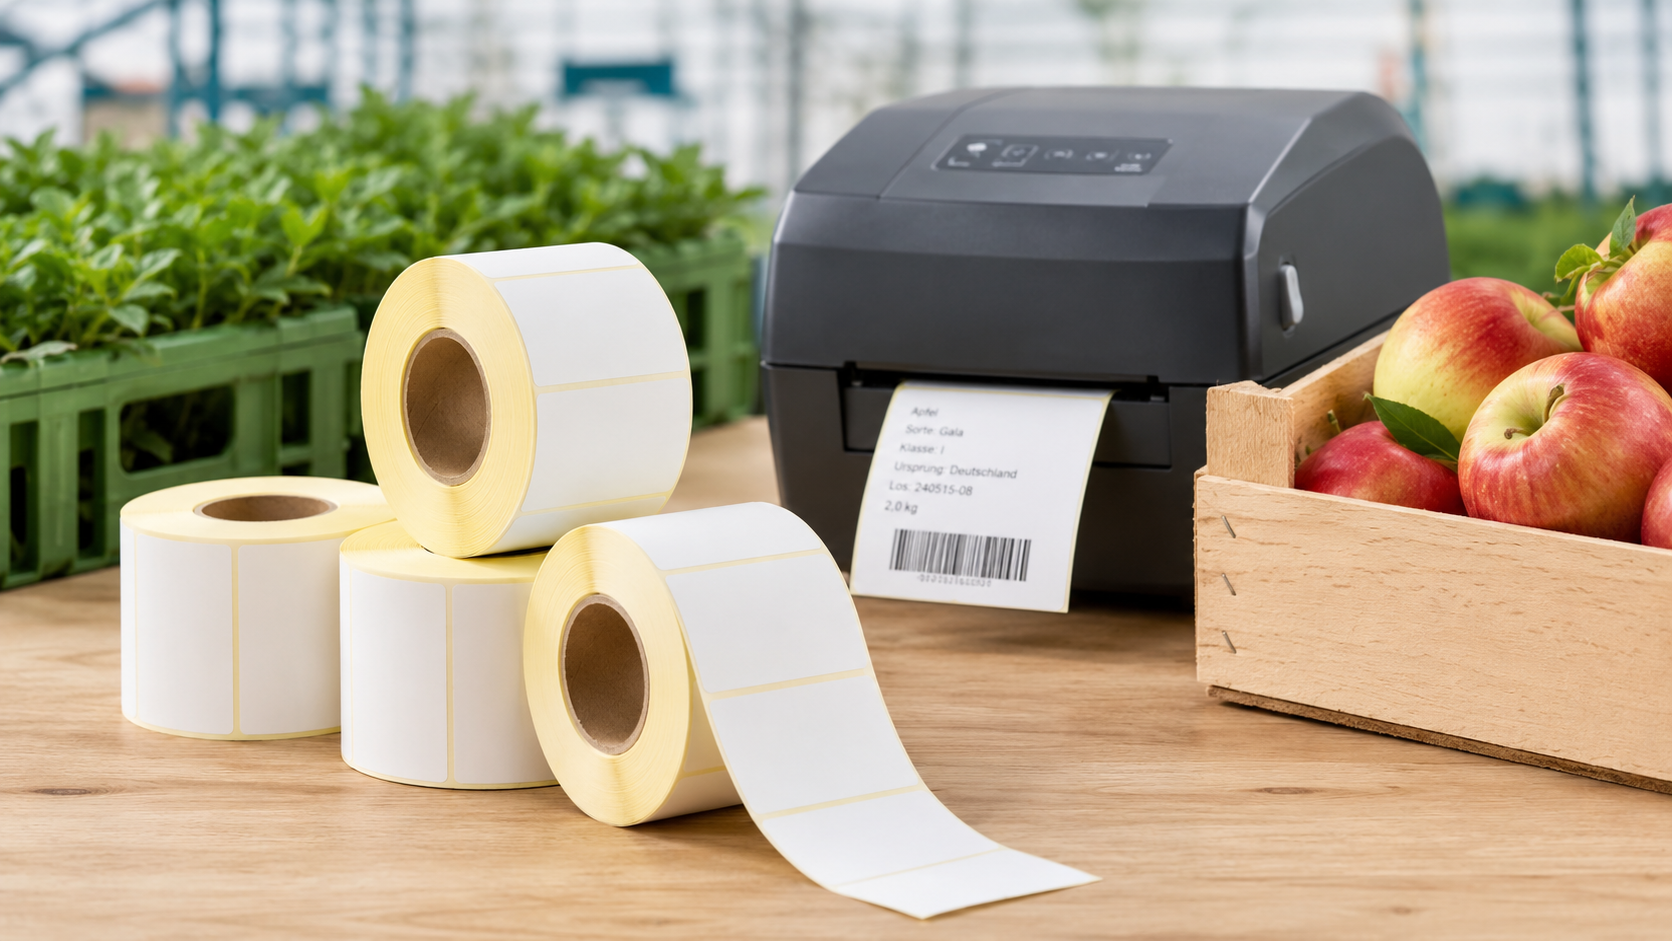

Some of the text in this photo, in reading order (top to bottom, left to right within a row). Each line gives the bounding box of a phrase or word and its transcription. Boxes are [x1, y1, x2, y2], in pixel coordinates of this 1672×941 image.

[911, 407, 938, 417] Apfel
[906, 424, 964, 437] Sorte: Gala
[900, 443, 937, 454] Klasse:
[894, 461, 1018, 479] Ursprung: Deutschland
[889, 481, 973, 496] Los: 240515-08
[884, 500, 918, 515] 2,0 kg
